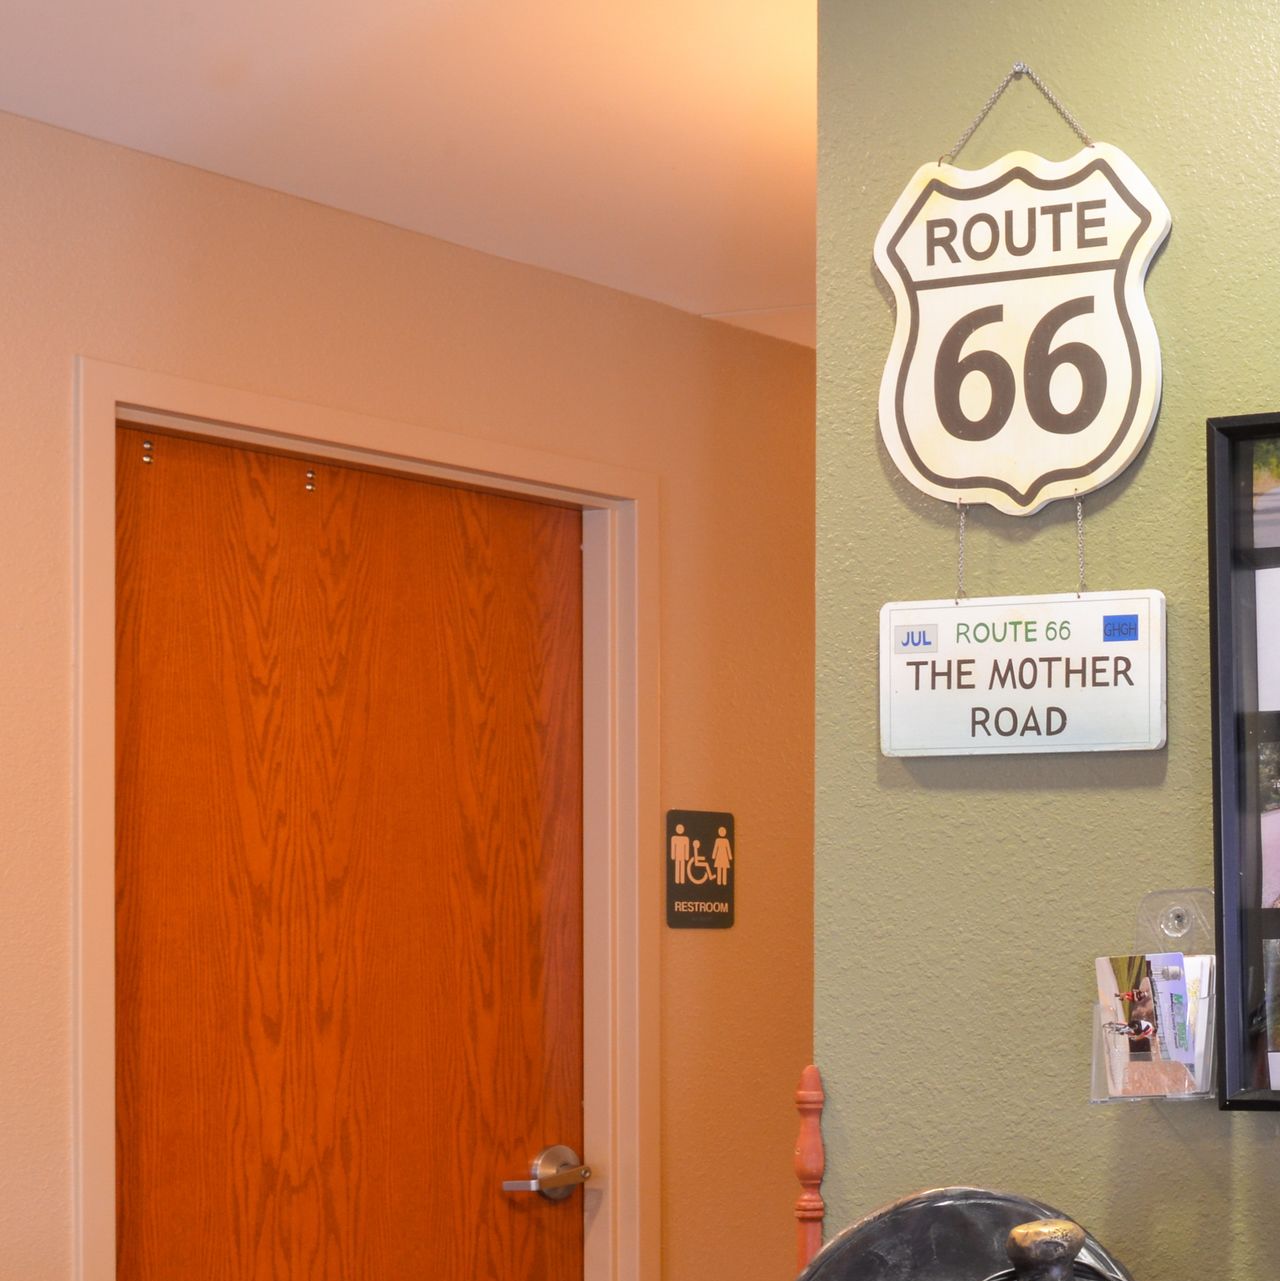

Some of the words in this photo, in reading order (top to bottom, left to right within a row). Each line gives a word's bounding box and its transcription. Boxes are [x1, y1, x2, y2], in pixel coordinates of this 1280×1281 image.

[926, 199, 1108, 266] ROUTE
[935, 295, 1108, 442] 66
[901, 630, 932, 647] JUL
[956, 621, 1038, 644] ROUTE
[1045, 621, 1071, 641] 66
[1103, 622, 1137, 636] GHGH
[906, 659, 976, 690] THE
[988, 656, 1135, 690] MOTHER
[971, 706, 1067, 738] ROAD
[675, 901, 728, 913] RESTROOM
